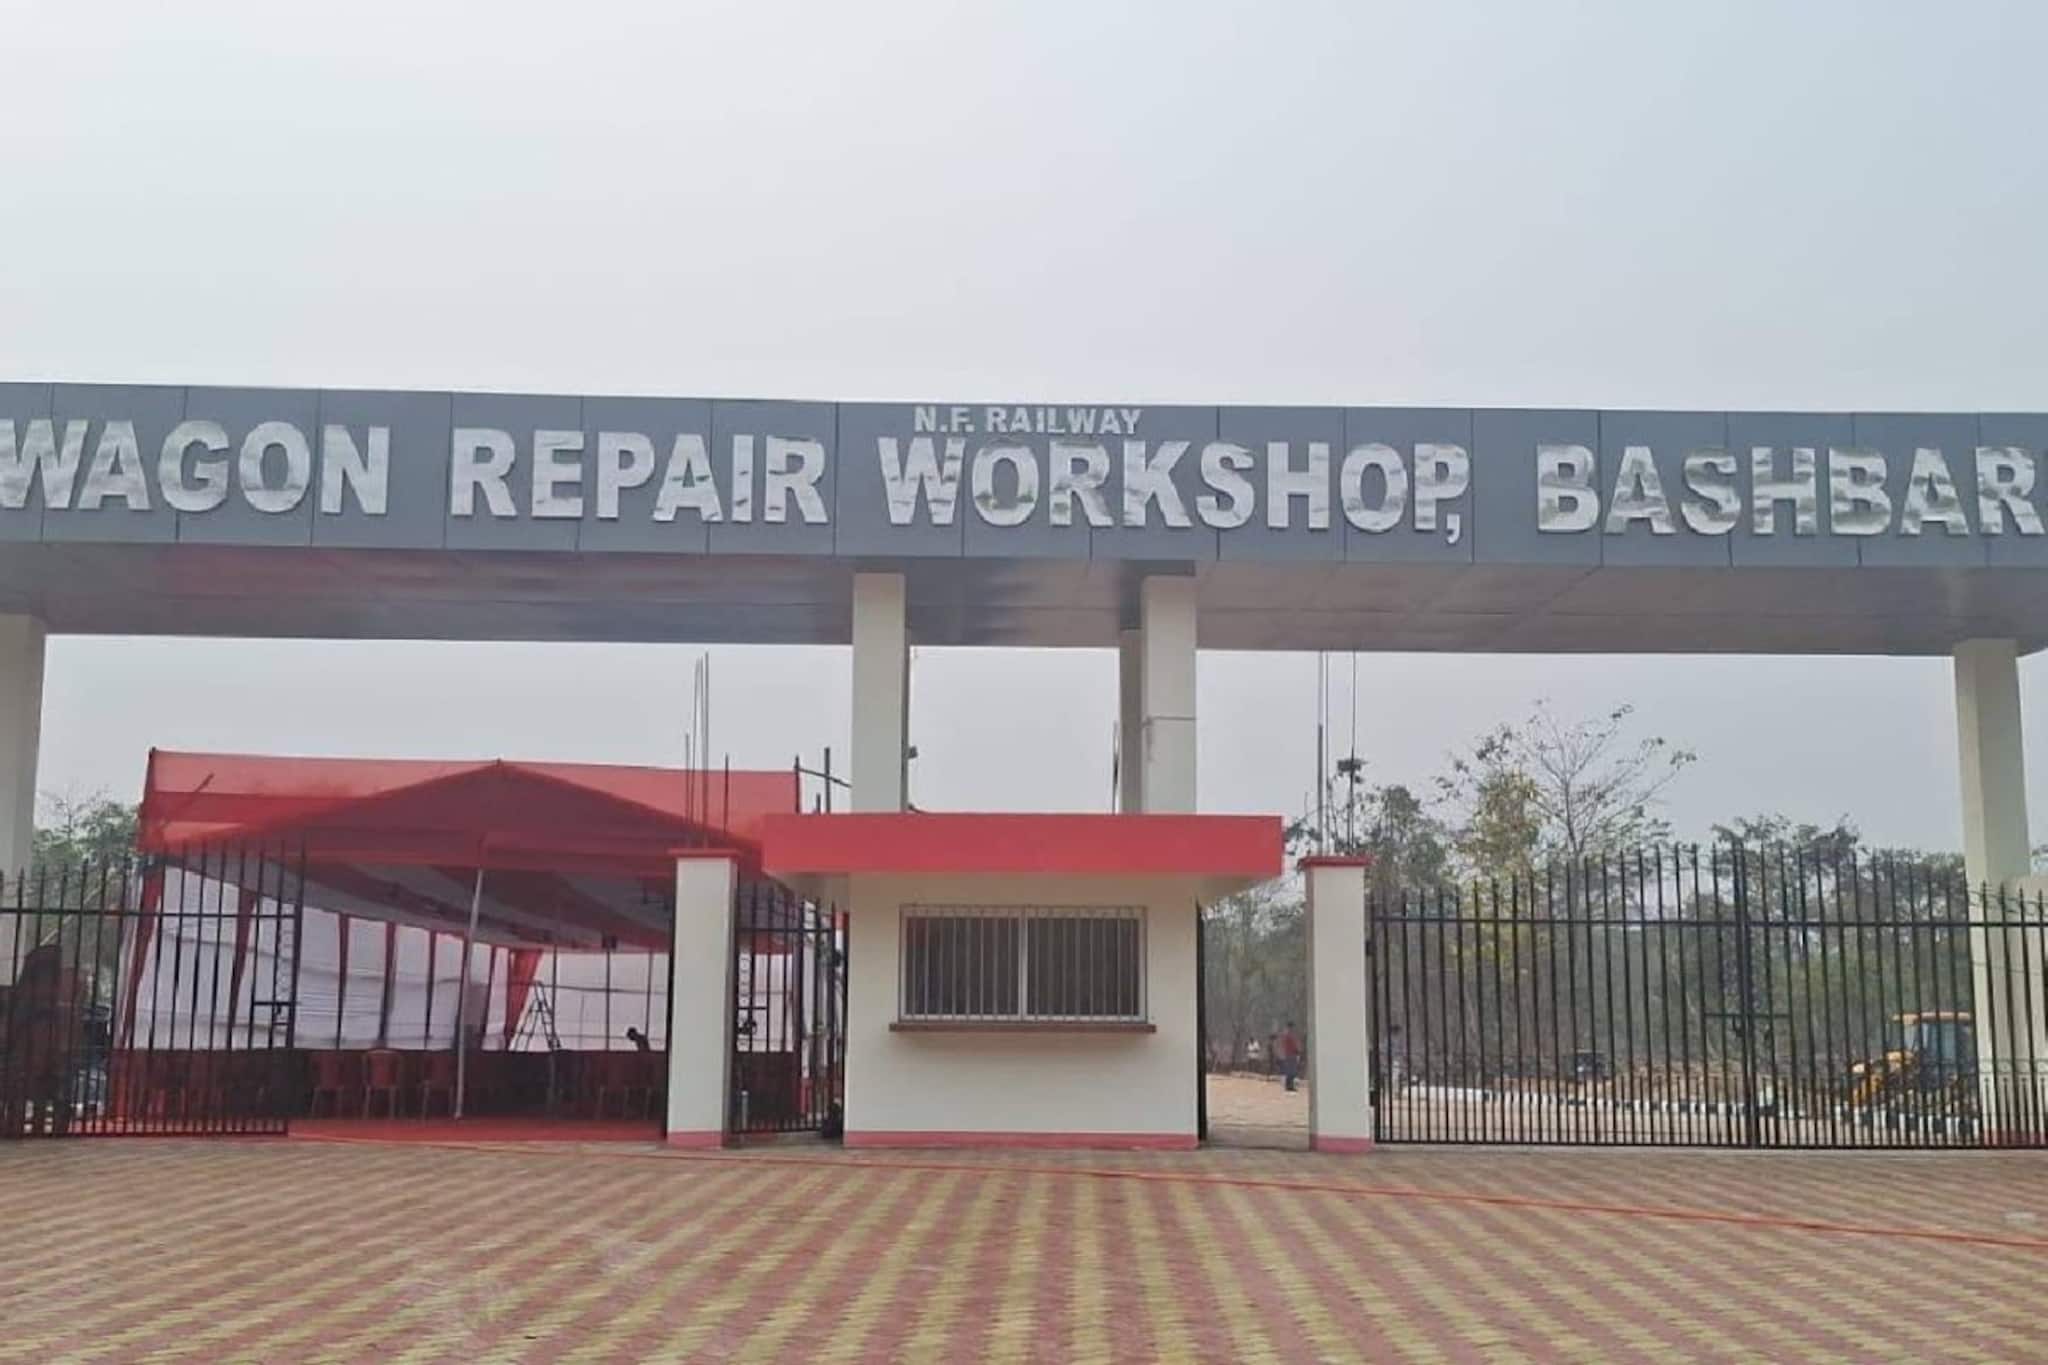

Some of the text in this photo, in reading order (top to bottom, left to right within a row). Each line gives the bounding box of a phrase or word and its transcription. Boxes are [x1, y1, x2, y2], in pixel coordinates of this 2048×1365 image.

[914, 406, 1142, 435] N.F. RAILWAY
[0, 418, 2046, 544] WAGON REPAIR WORKSHOP, BASHBAR
